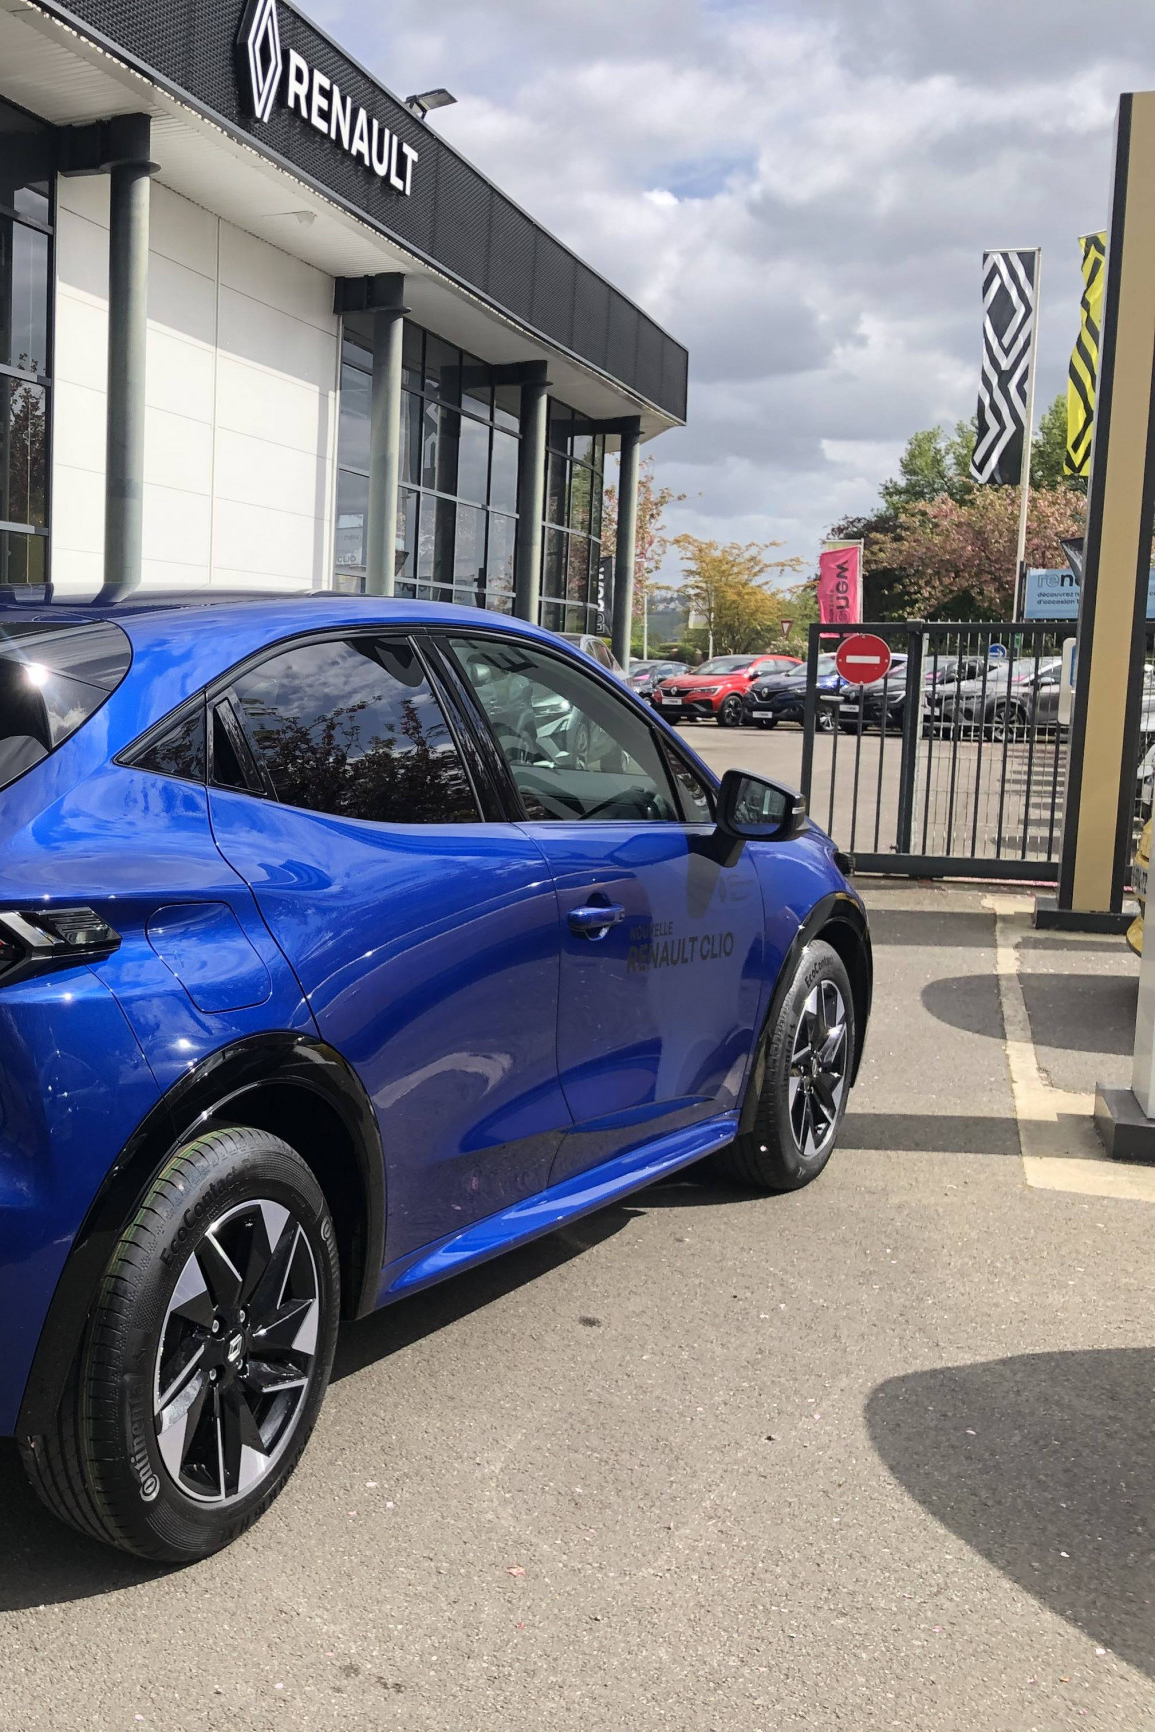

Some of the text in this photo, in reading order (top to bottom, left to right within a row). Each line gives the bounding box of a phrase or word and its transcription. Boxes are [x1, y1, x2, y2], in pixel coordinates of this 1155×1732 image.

[287, 48, 419, 196] RENAULT
[626, 931, 734, 974] RENAULT CLIO
[629, 921, 674, 942] NOUVELLE
